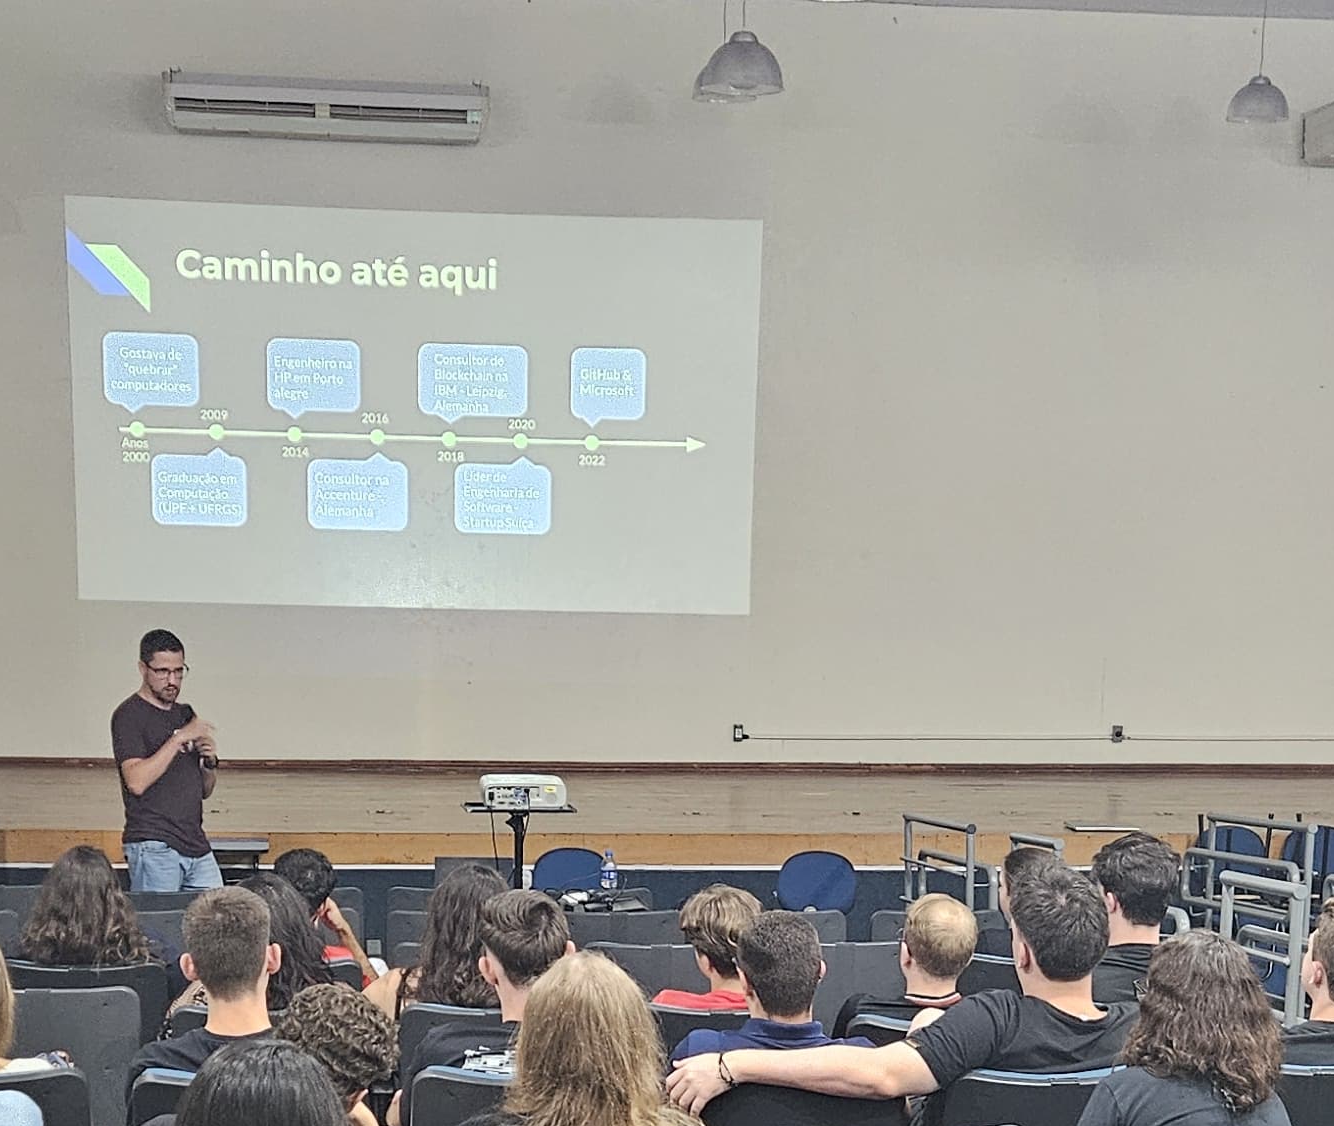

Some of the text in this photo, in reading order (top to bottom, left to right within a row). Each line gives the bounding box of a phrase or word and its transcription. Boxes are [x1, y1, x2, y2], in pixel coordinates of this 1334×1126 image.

[175, 248, 498, 296] Caminho até aqui
[119, 346, 183, 361] Gostava de
[434, 352, 505, 367] Consultor de
[273, 355, 353, 369] Engenheiro na
[273, 371, 344, 385] HP em Porto
[434, 368, 509, 382] Blockchain na
[580, 368, 633, 381] GitHub &
[110, 379, 192, 393] computadores
[434, 384, 457, 396] IBM
[578, 383, 636, 397] Microsoft
[273, 387, 309, 400] alegre
[434, 400, 489, 413] Alemanha
[199, 409, 229, 421] 2009
[361, 412, 390, 424] 2016
[507, 418, 536, 430] 2020
[121, 436, 149, 449] Anos
[122, 451, 151, 463] 2000
[281, 446, 310, 458] 2014
[436, 450, 464, 463] 2018
[578, 454, 606, 466] 2022
[157, 470, 237, 486] Graduação em
[314, 471, 390, 487] Consultor na
[493, 471, 508, 483] de
[158, 486, 229, 501] Computação
[315, 488, 377, 502] Accenture
[463, 485, 540, 500] Engenharia de
[198, 502, 243, 516] UFRGS)
[315, 504, 375, 518] Alemanha
[463, 500, 513, 513] Software
[463, 516, 505, 530] Startup
